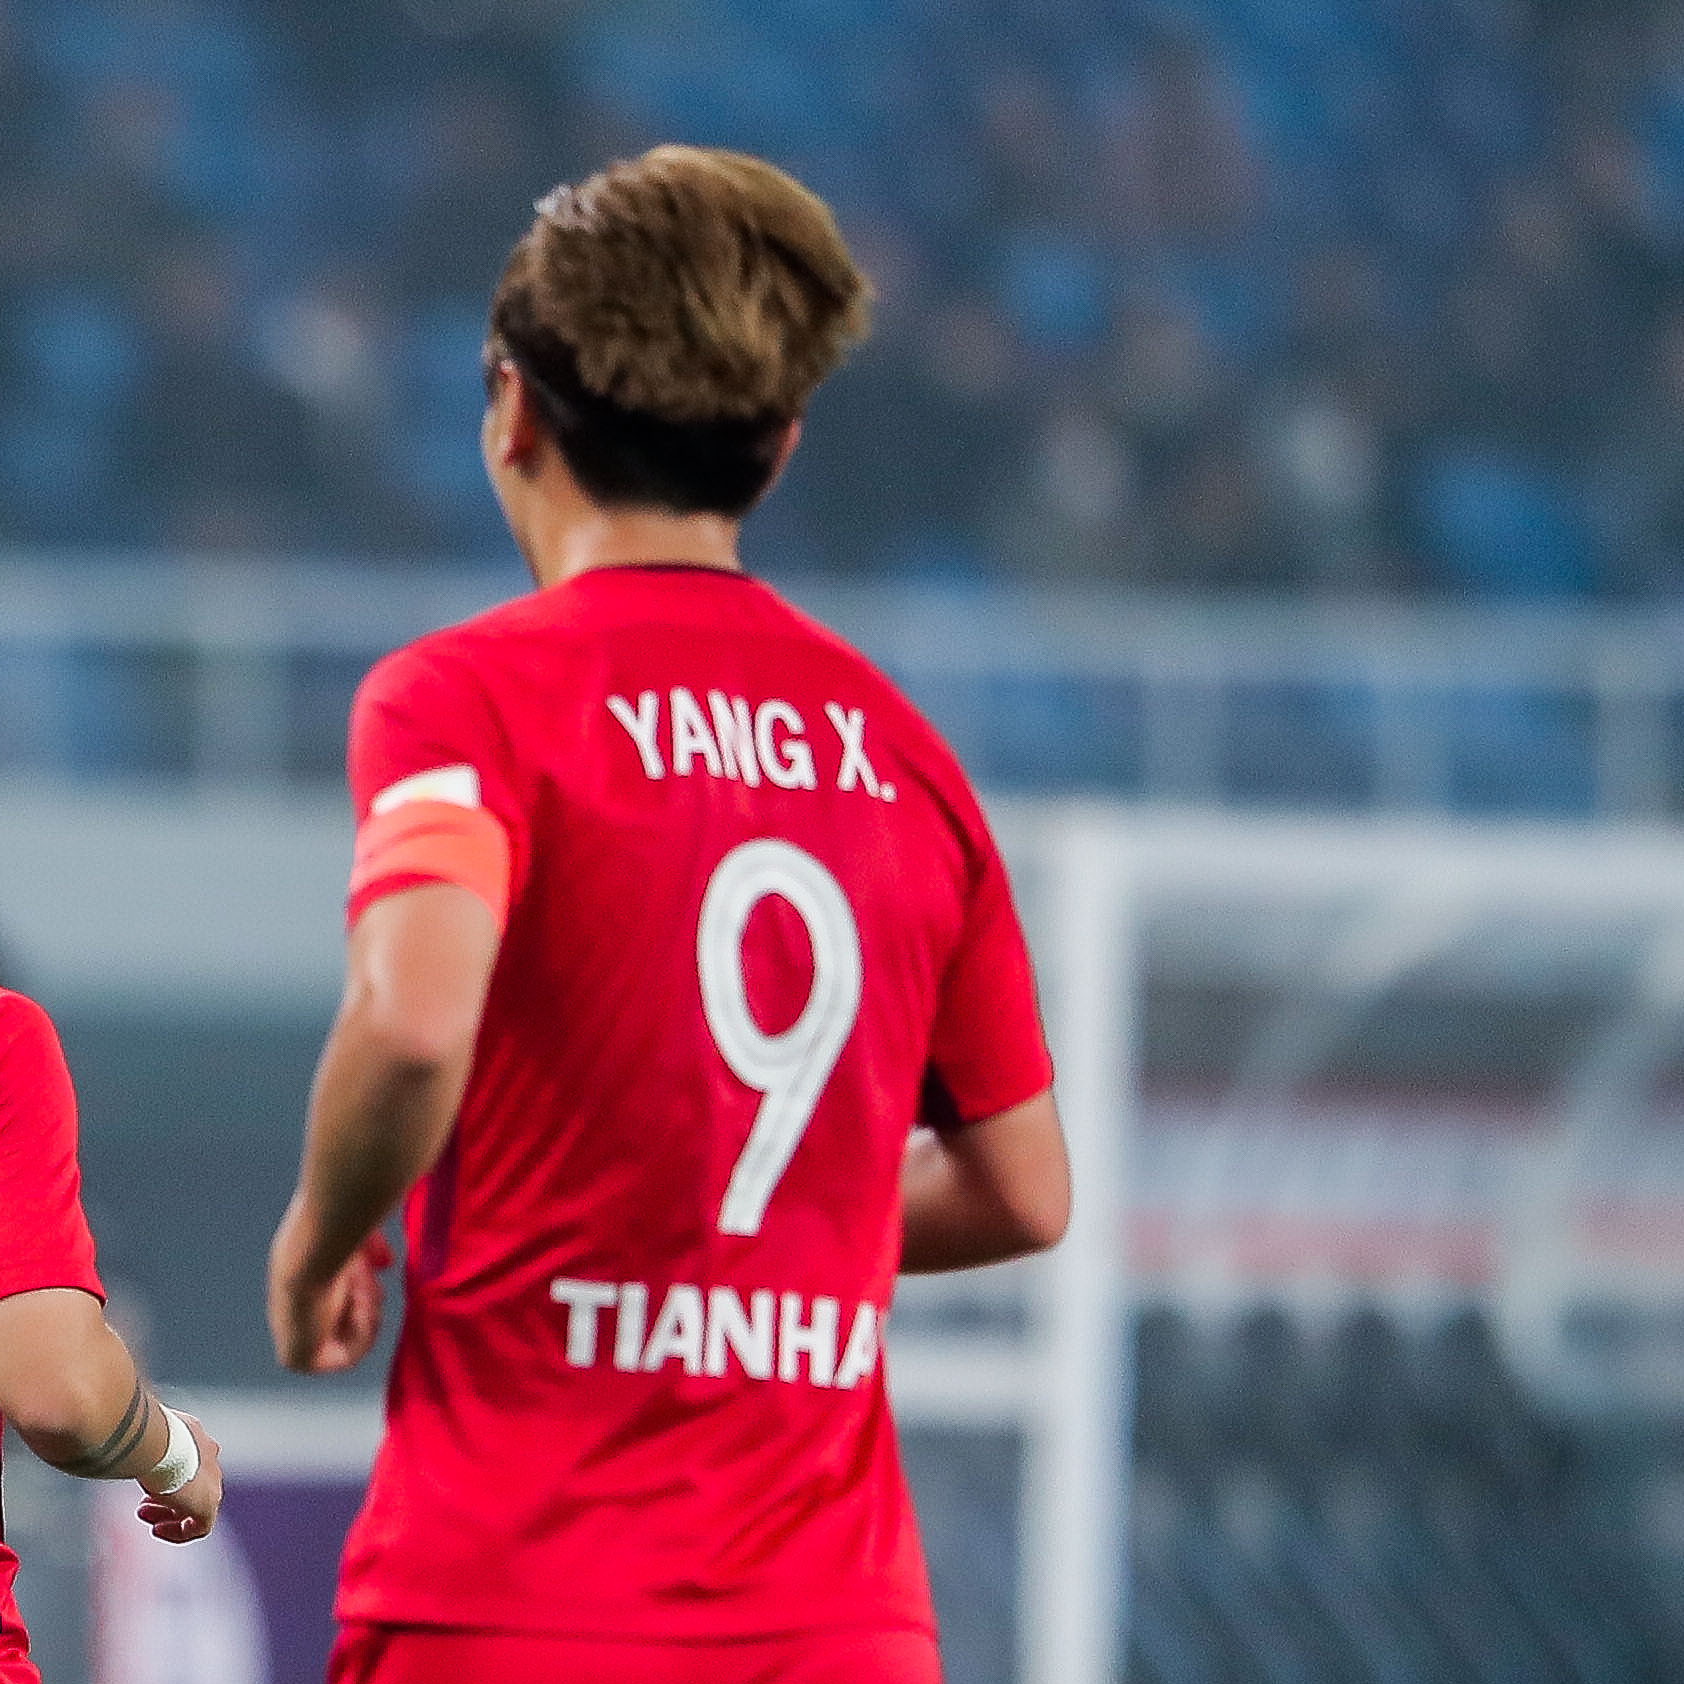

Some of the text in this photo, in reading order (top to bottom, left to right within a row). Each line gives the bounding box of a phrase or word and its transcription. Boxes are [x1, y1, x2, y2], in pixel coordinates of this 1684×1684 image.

[607, 686, 898, 802] YANG X.
[697, 838, 864, 1237] 9
